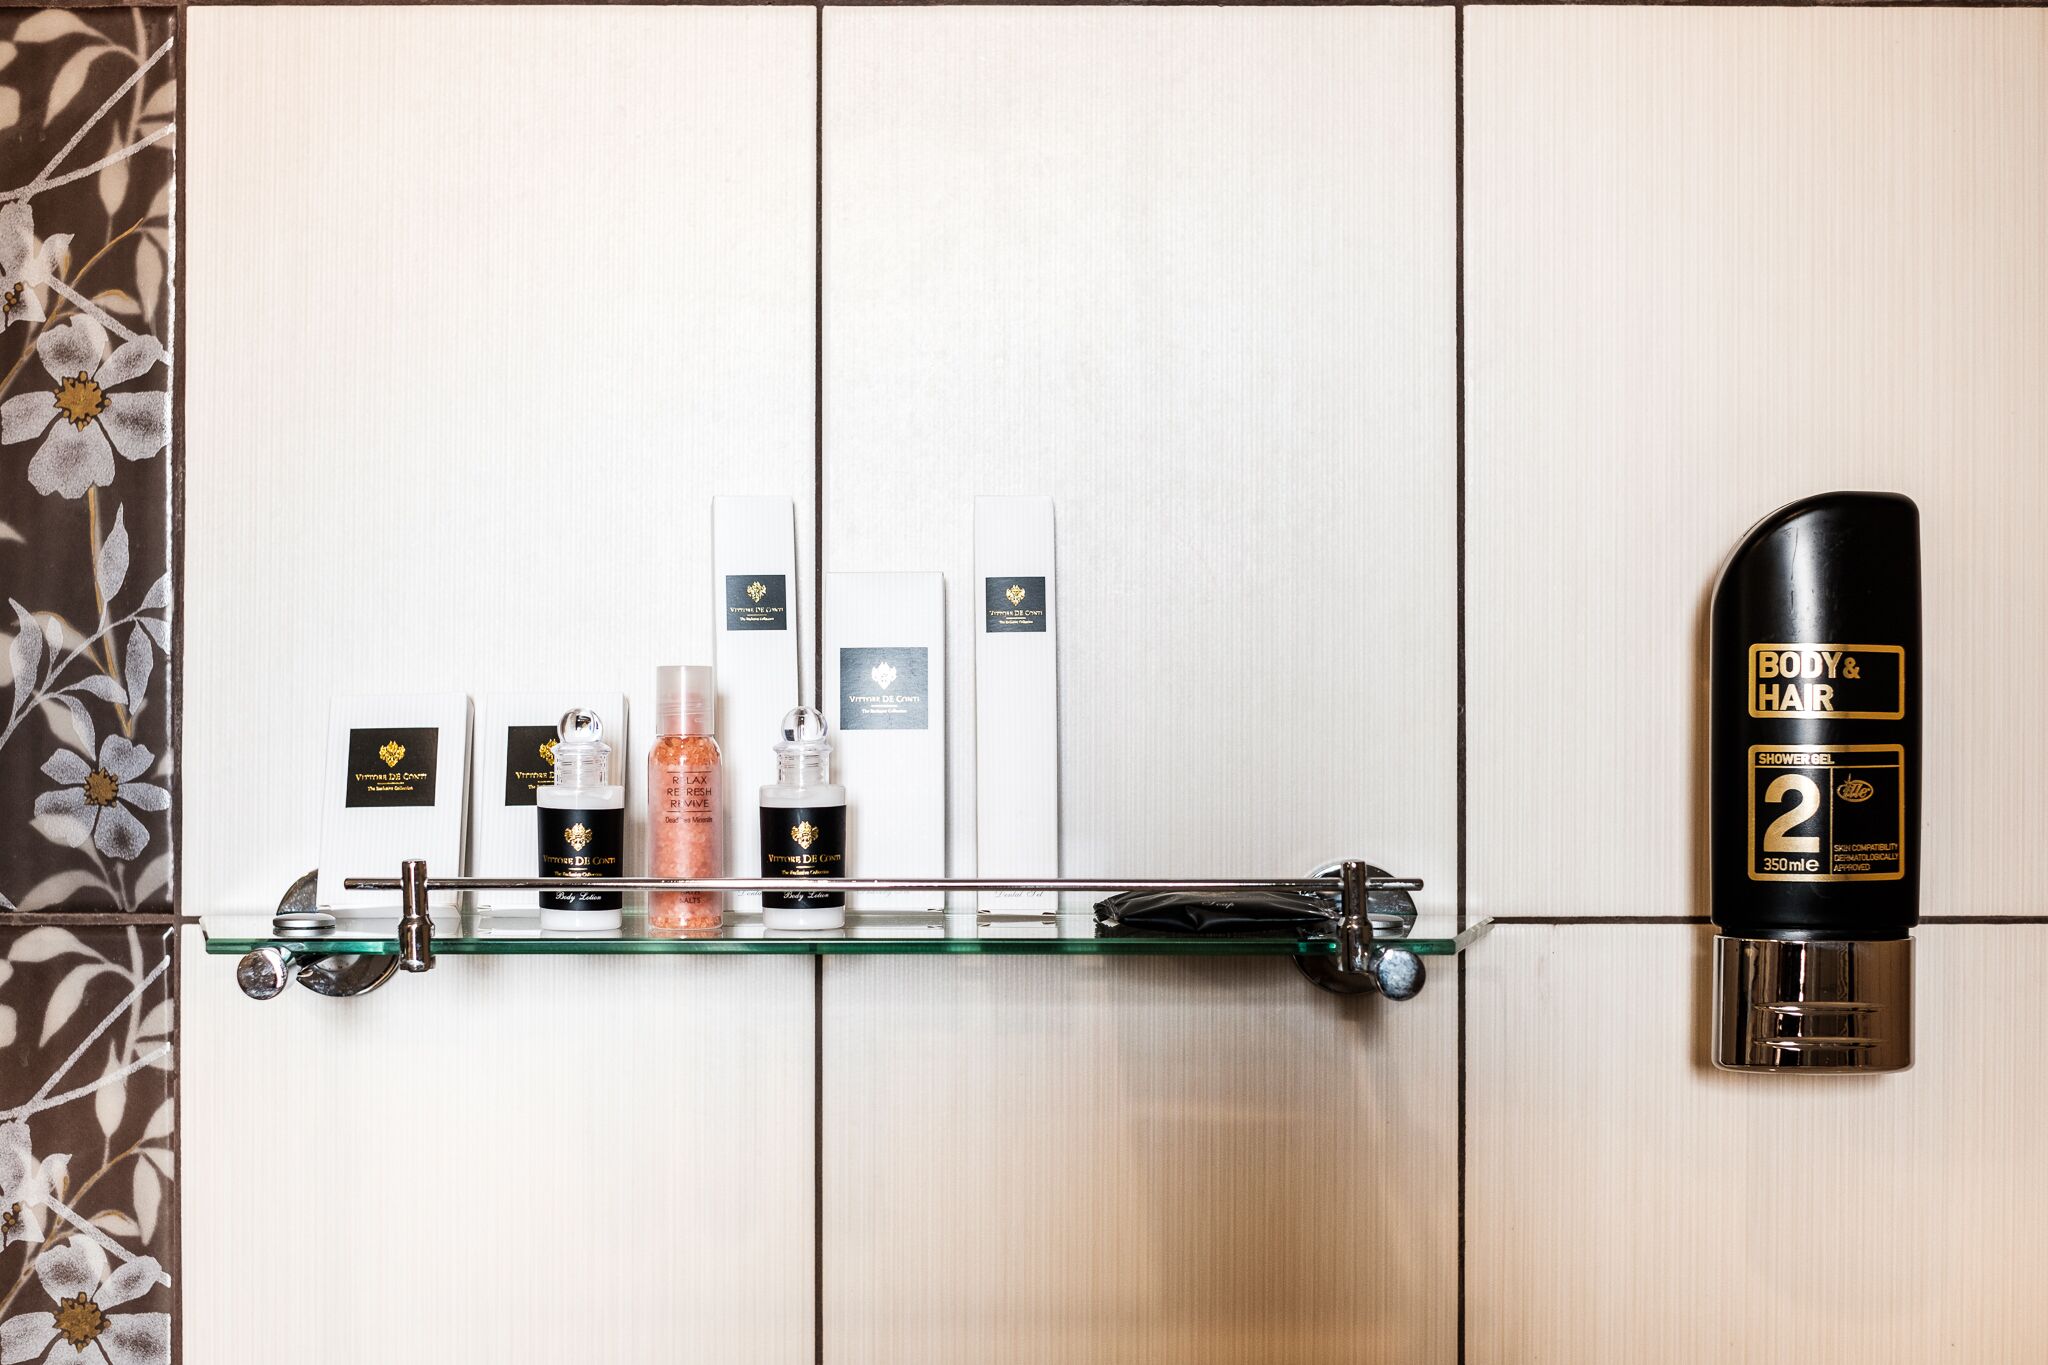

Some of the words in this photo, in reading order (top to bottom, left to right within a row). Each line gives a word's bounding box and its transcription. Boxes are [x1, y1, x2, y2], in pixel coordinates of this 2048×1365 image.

[882, 695, 895, 703] DE
[1758, 683, 1834, 711] HAIR
[1758, 753, 1811, 765] SHOWER
[1811, 753, 1835, 765] GEL
[388, 773, 401, 781] DE
[672, 776, 707, 785] RLAX
[666, 787, 712, 796] RERESH
[1763, 773, 1820, 853] 2
[543, 854, 574, 866] VITTORE
[575, 856, 590, 866] DE
[592, 856, 616, 866] CONTI
[768, 854, 801, 864] VITTORE
[803, 854, 818, 864] DE
[819, 854, 841, 863] CONTI
[1833, 853, 1898, 862] DERMATOLOGICALLY
[1833, 863, 1871, 872] APPROVED
[555, 891, 576, 903] Body
[579, 891, 602, 901] Lotion
[783, 891, 804, 902] Body
